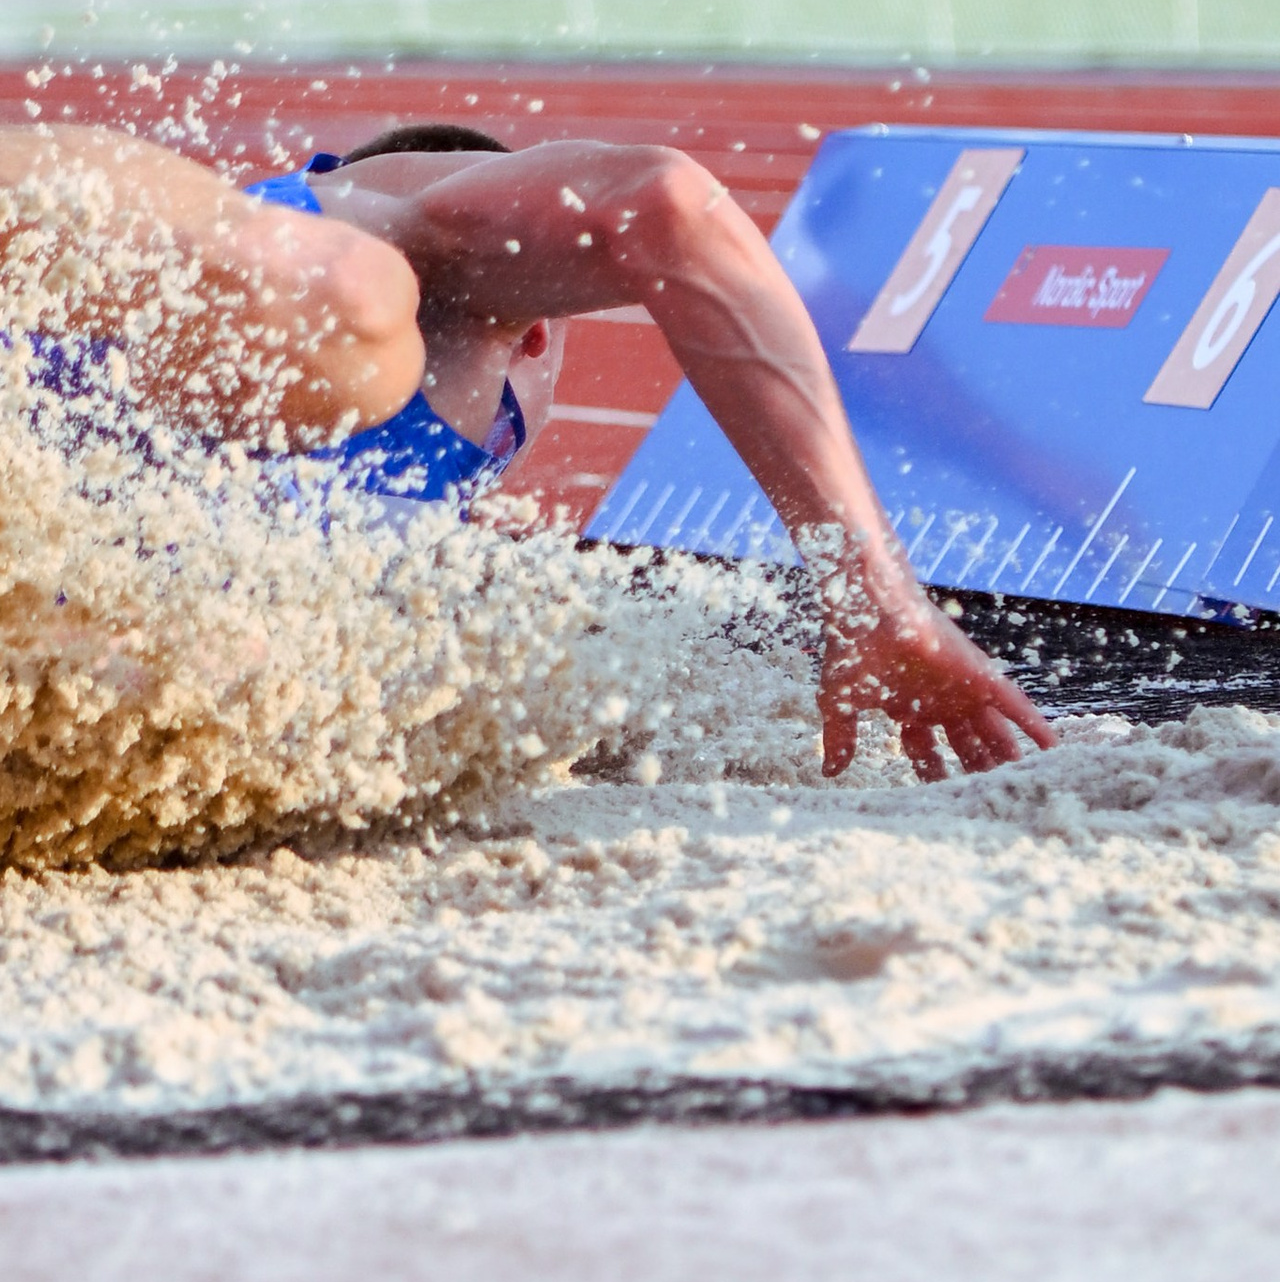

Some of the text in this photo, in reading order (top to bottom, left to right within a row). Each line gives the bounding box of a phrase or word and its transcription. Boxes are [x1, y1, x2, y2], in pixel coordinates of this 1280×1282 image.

[890, 186, 983, 317] 5
[1087, 266, 1147, 319] Sport
[1192, 232, 1280, 371] 6
